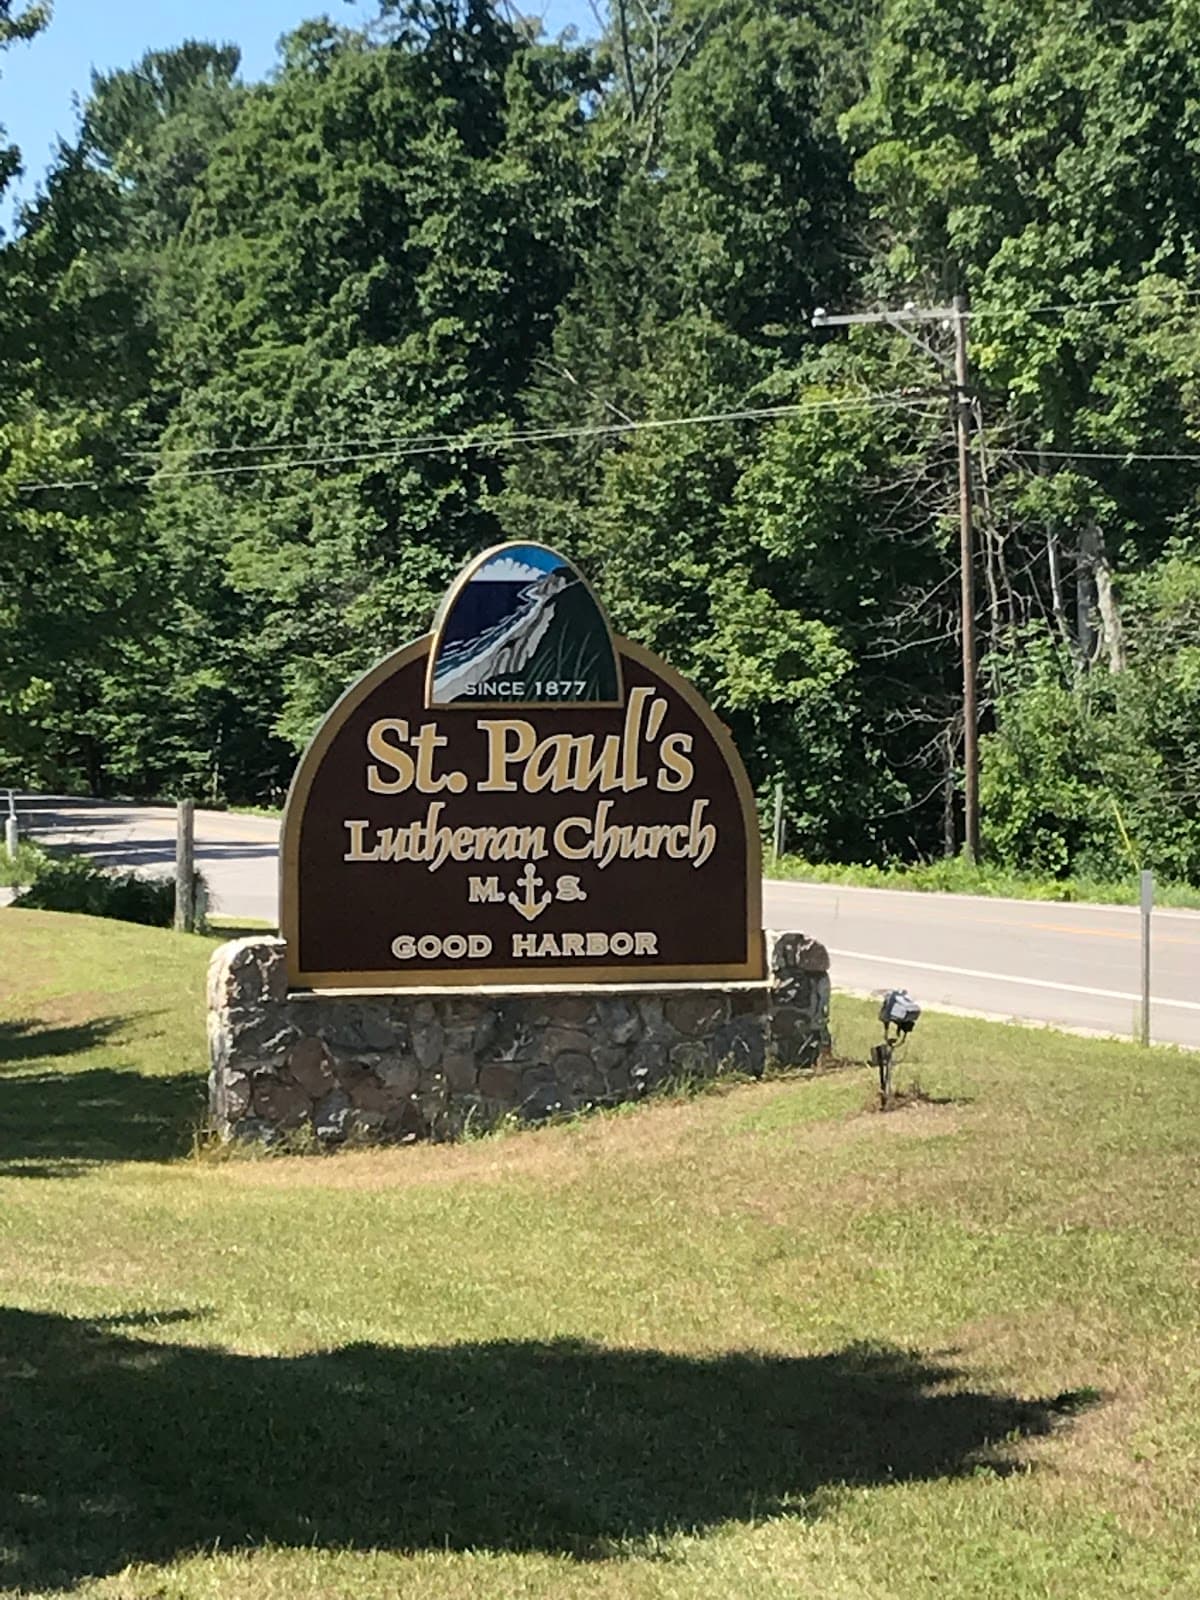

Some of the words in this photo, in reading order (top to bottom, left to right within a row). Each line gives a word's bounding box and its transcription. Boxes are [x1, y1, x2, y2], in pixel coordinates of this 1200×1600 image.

[464, 681, 525, 697] SINCE
[534, 680, 588, 696] 1877
[366, 718, 468, 795] St.
[477, 686, 694, 793] Paul's
[344, 801, 549, 872] Lutheran
[553, 798, 717, 869] Church
[468, 876, 505, 903] M.
[555, 875, 587, 902] S.
[391, 934, 493, 959] GOOD
[512, 932, 659, 957] HARBOR
